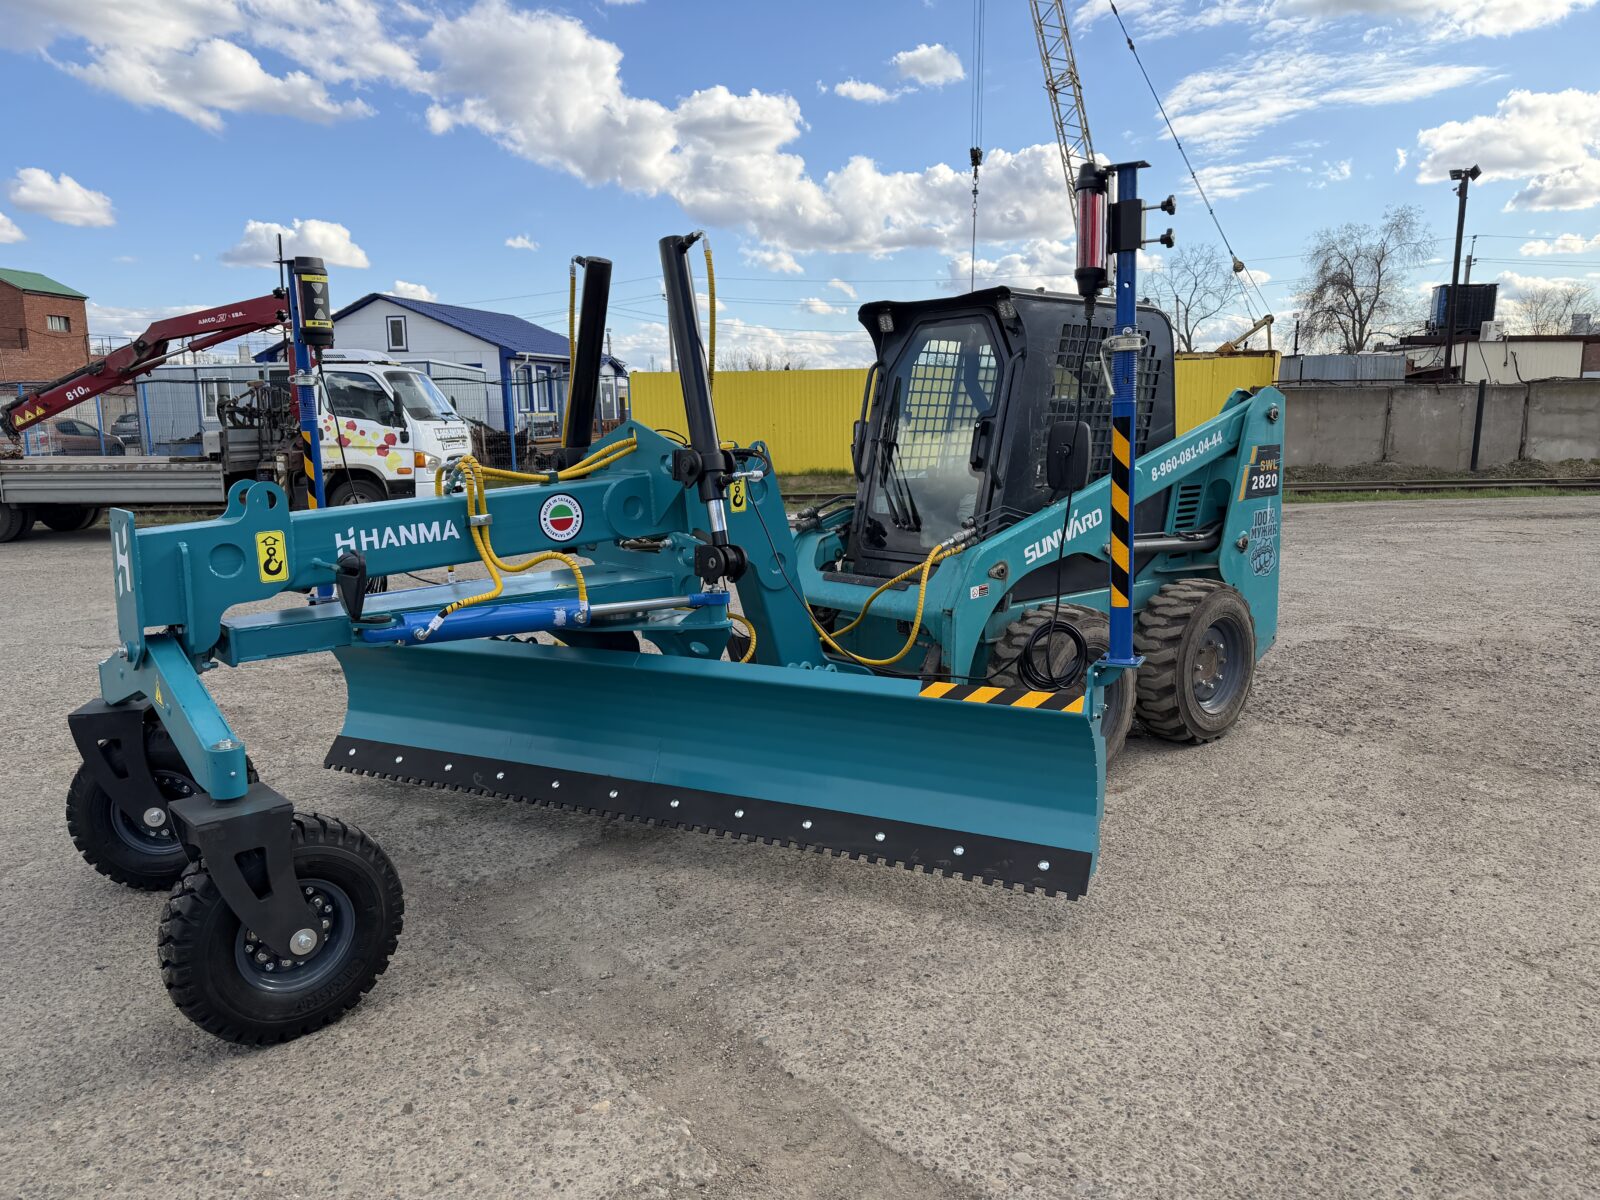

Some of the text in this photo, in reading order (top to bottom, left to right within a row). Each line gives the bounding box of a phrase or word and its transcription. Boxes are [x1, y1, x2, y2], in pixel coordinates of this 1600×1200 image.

[65, 386, 85, 401] 810
[1151, 430, 1223, 482] 8-960-081-04-44
[1260, 458, 1278, 472] SWL
[1251, 473, 1278, 490] 2820
[1254, 509, 1275, 527] 100%
[360, 519, 460, 551] HANMA
[1023, 508, 1103, 565] SUNWARD
[1250, 525, 1277, 540] МУЖИК
